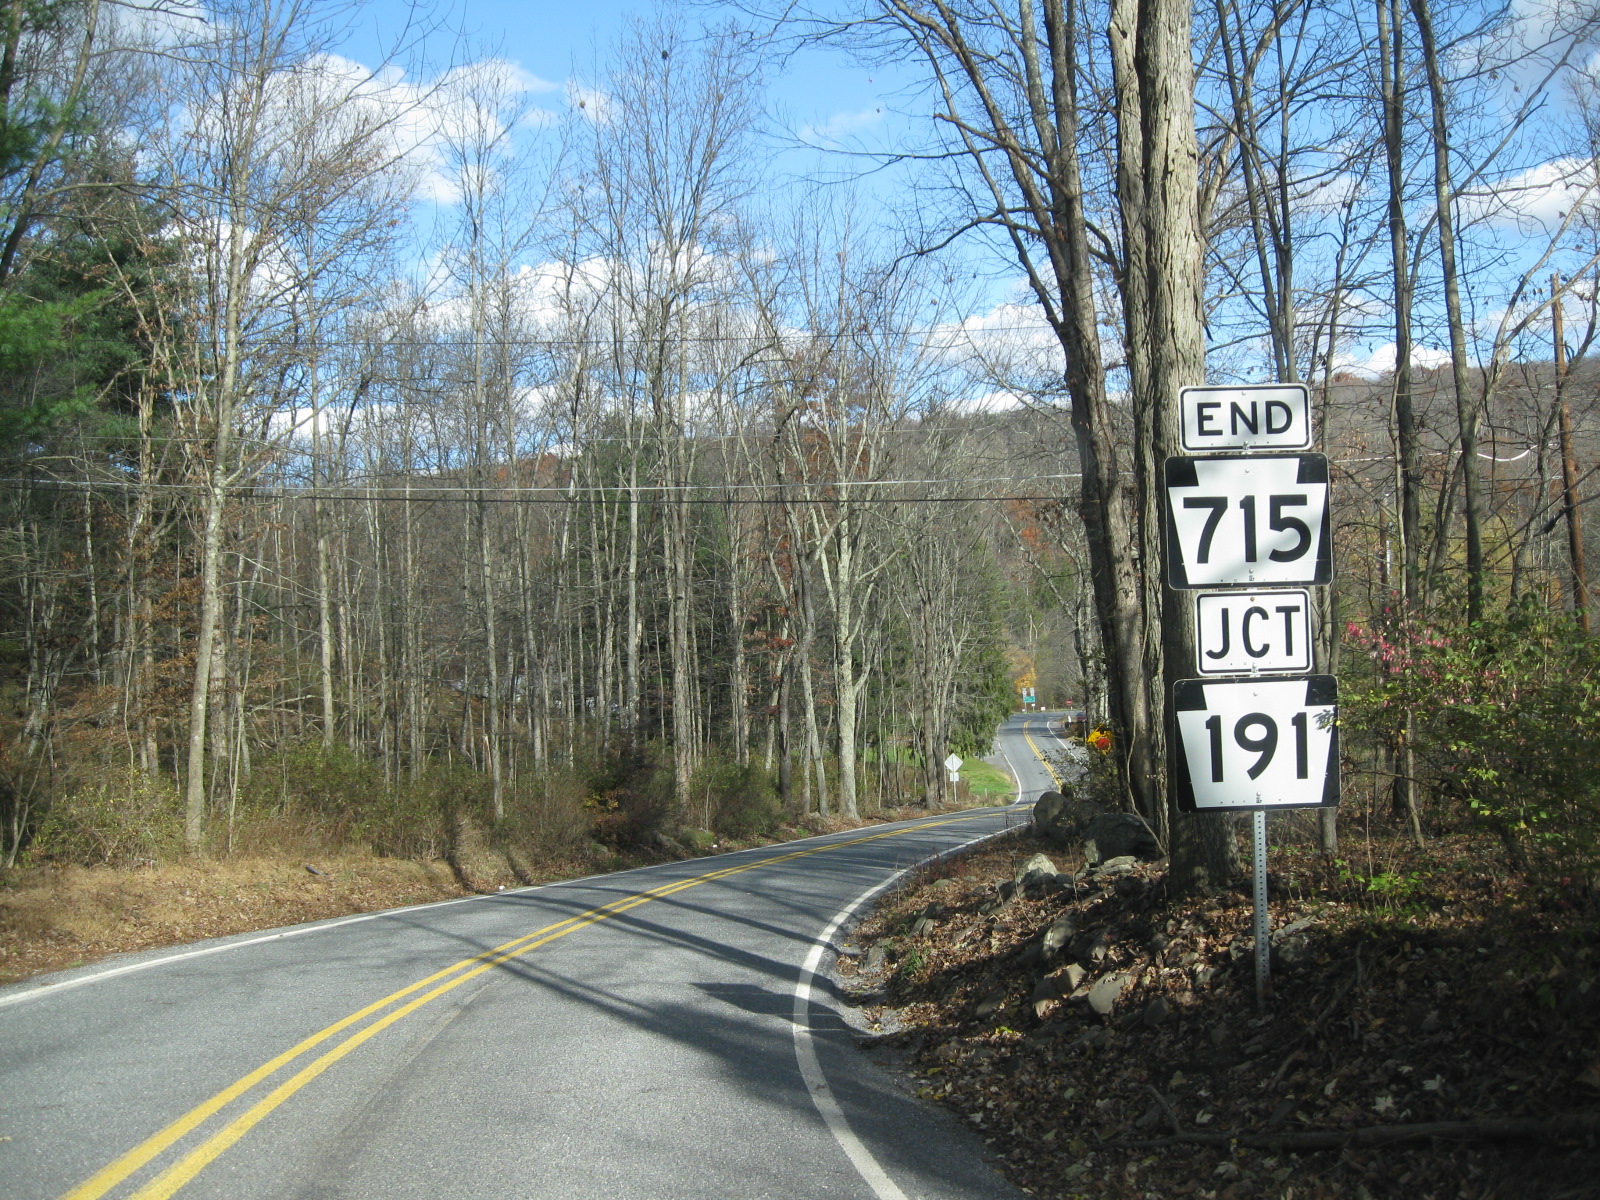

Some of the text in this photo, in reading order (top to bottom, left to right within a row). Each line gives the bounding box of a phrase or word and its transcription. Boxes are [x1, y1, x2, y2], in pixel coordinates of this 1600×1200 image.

[1196, 401, 1293, 436] END
[1183, 494, 1312, 564] 715
[1205, 605, 1301, 660] JCT
[1205, 712, 1308, 783] 191
